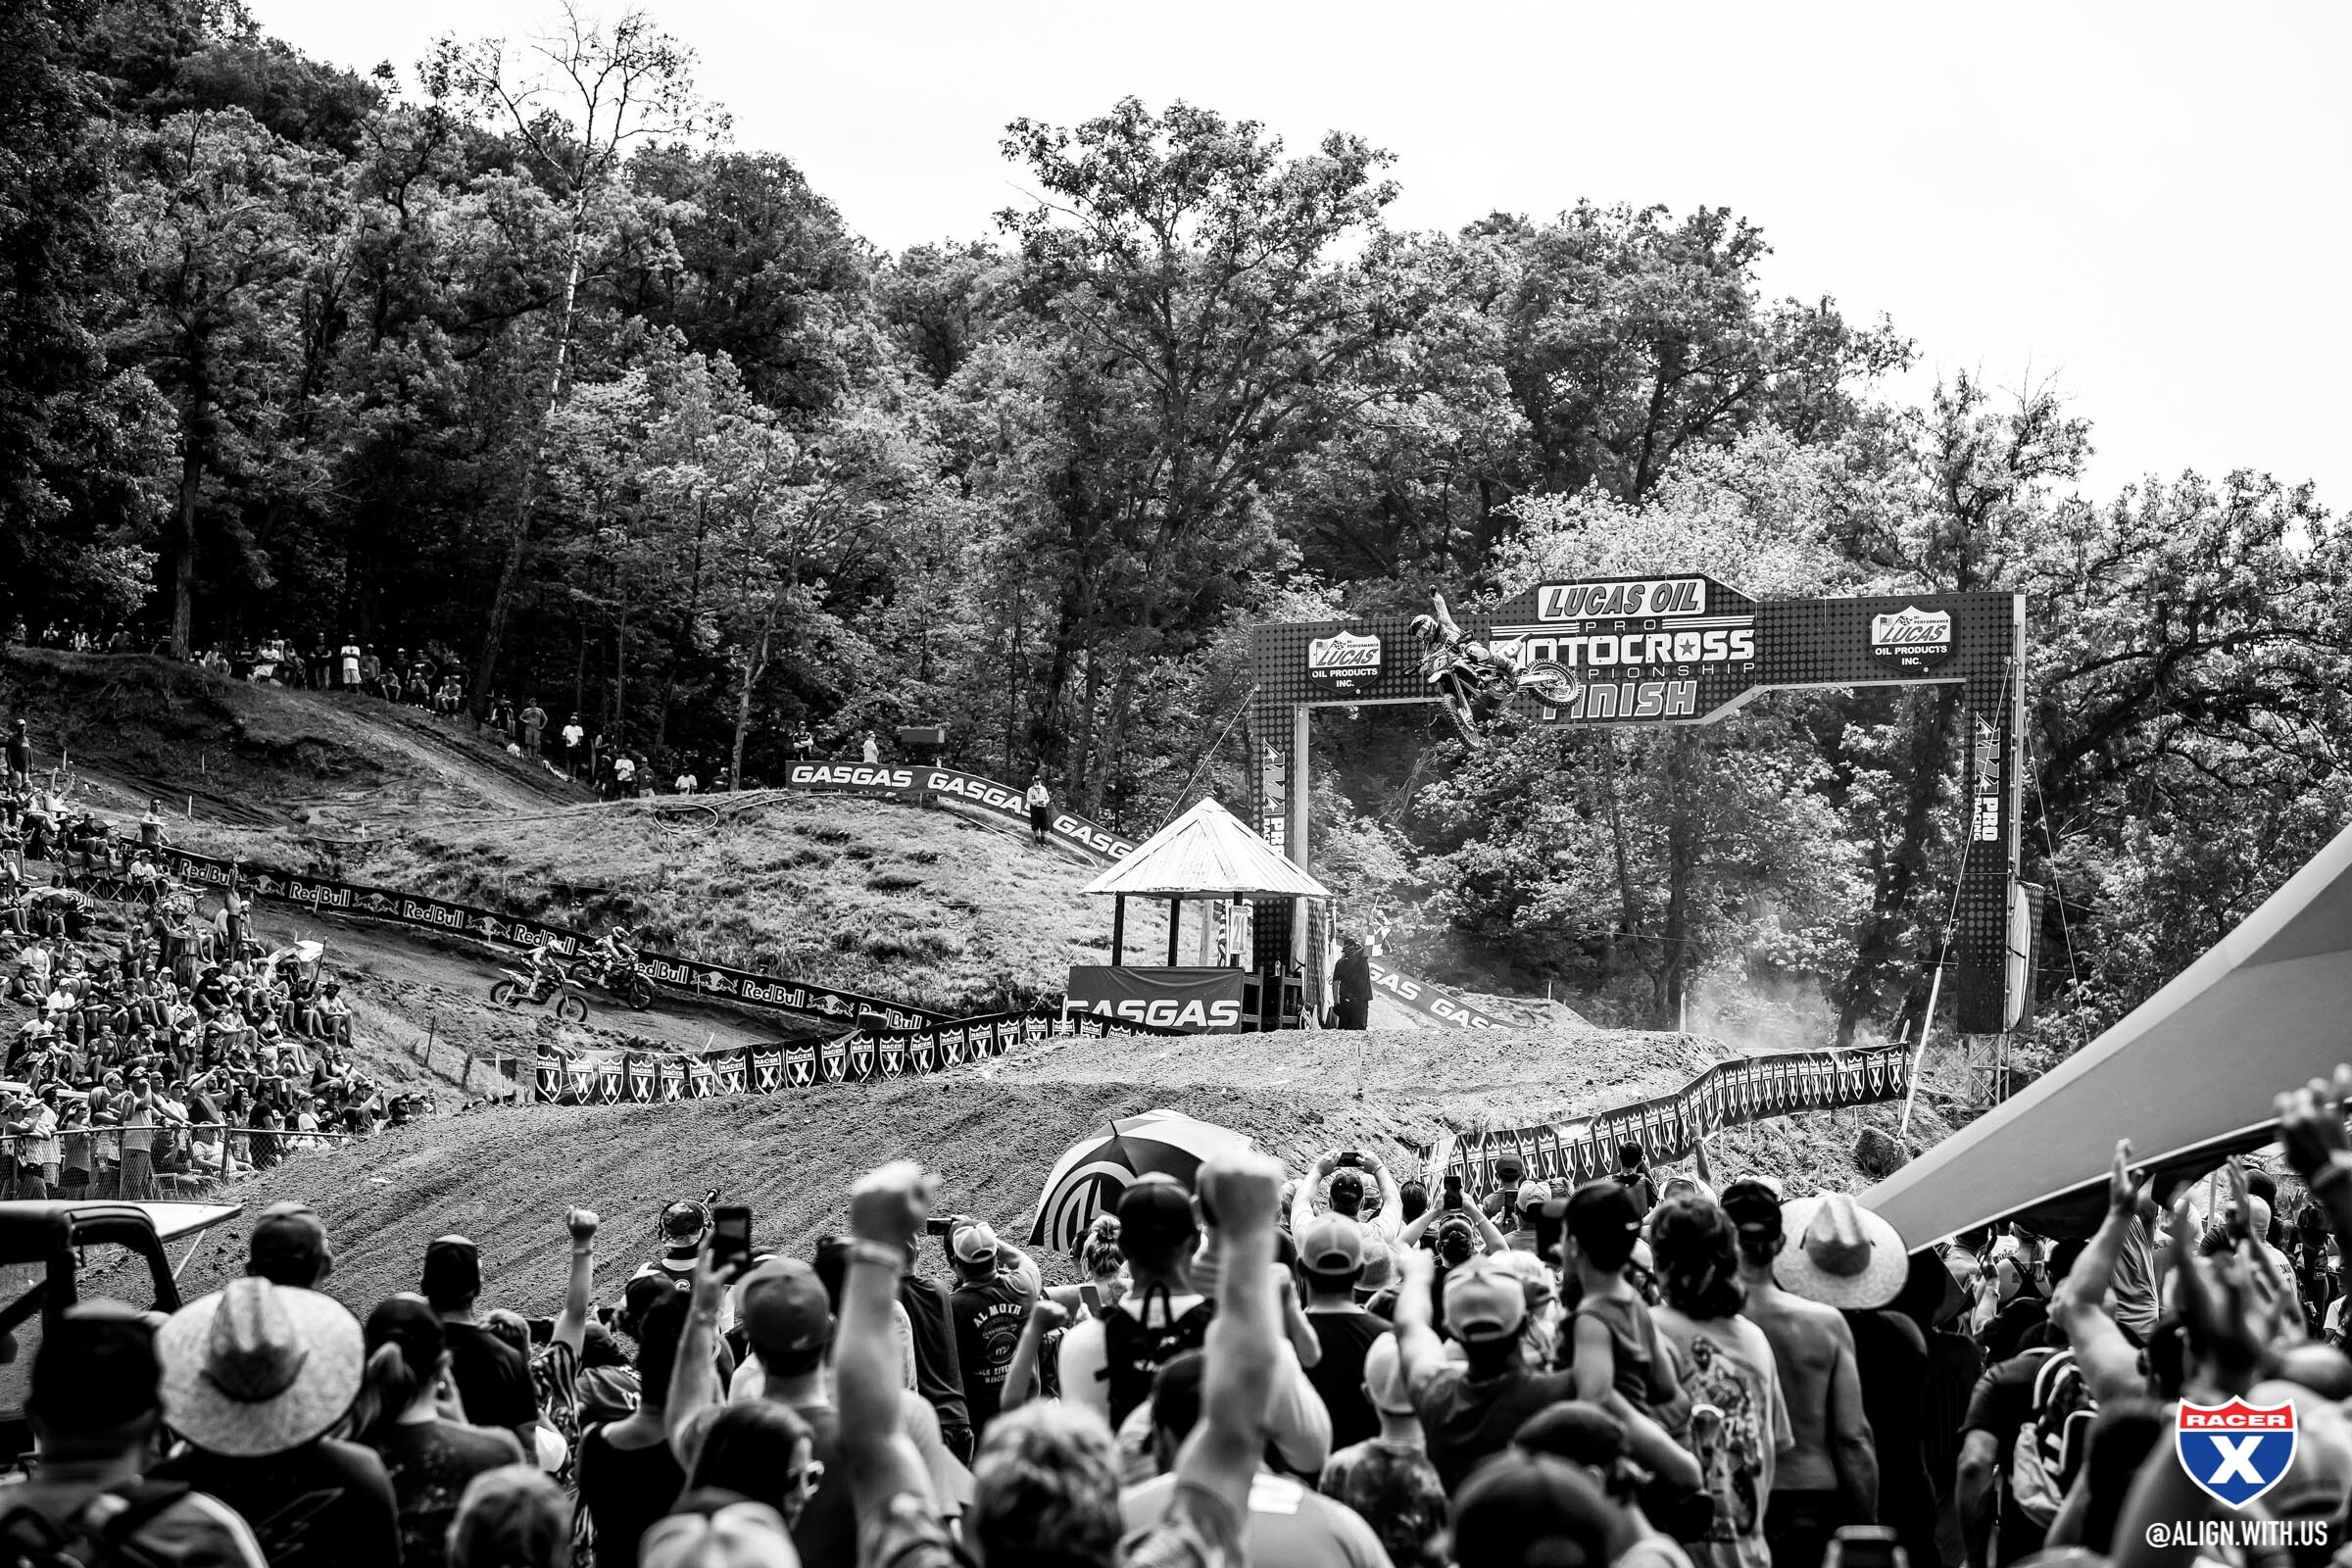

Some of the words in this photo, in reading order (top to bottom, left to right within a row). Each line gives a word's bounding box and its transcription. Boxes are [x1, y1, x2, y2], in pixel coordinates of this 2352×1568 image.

[1545, 586, 1642, 617] LUCAS
[1650, 582, 1698, 612] OIL
[1585, 619, 1656, 632] PRO
[1879, 624, 1947, 643] LUCAS
[1316, 648, 1379, 666] LUCAS
[1875, 647, 1892, 656] OIL
[1894, 645, 1948, 655] PRODUCTS
[1329, 667, 1378, 677] PRODUCTS
[1588, 662, 1755, 679] PIONSHIP
[791, 765, 913, 787] GASGAS
[1973, 797, 1983, 841] RACING
[1982, 797, 1999, 841] PRO
[1053, 814, 1133, 859] GASG
[1368, 961, 1422, 1001] GAS
[947, 1044, 960, 1064] X
[976, 1039, 988, 1058] X
[1004, 1034, 1014, 1053] X
[795, 1061, 810, 1083] X
[828, 1057, 841, 1077] X
[886, 1052, 900, 1071] X
[545, 1070, 558, 1092] X
[575, 1072, 589, 1094] X
[606, 1074, 617, 1096] X
[727, 1071, 742, 1093] X
[760, 1067, 775, 1088] X
[1852, 1070, 1862, 1090] X
[1872, 1068, 1882, 1087] X
[1892, 1064, 1901, 1085] X
[636, 1077, 649, 1098] X
[667, 1079, 680, 1101] X
[697, 1077, 710, 1098] X
[1649, 1125, 1660, 1149] X
[1666, 1121, 1675, 1144] X
[1564, 1148, 1574, 1172] X
[1582, 1144, 1593, 1167] X
[1600, 1139, 1611, 1163] X
[1544, 1151, 1556, 1175] X
[973, 1312, 988, 1328] AL
